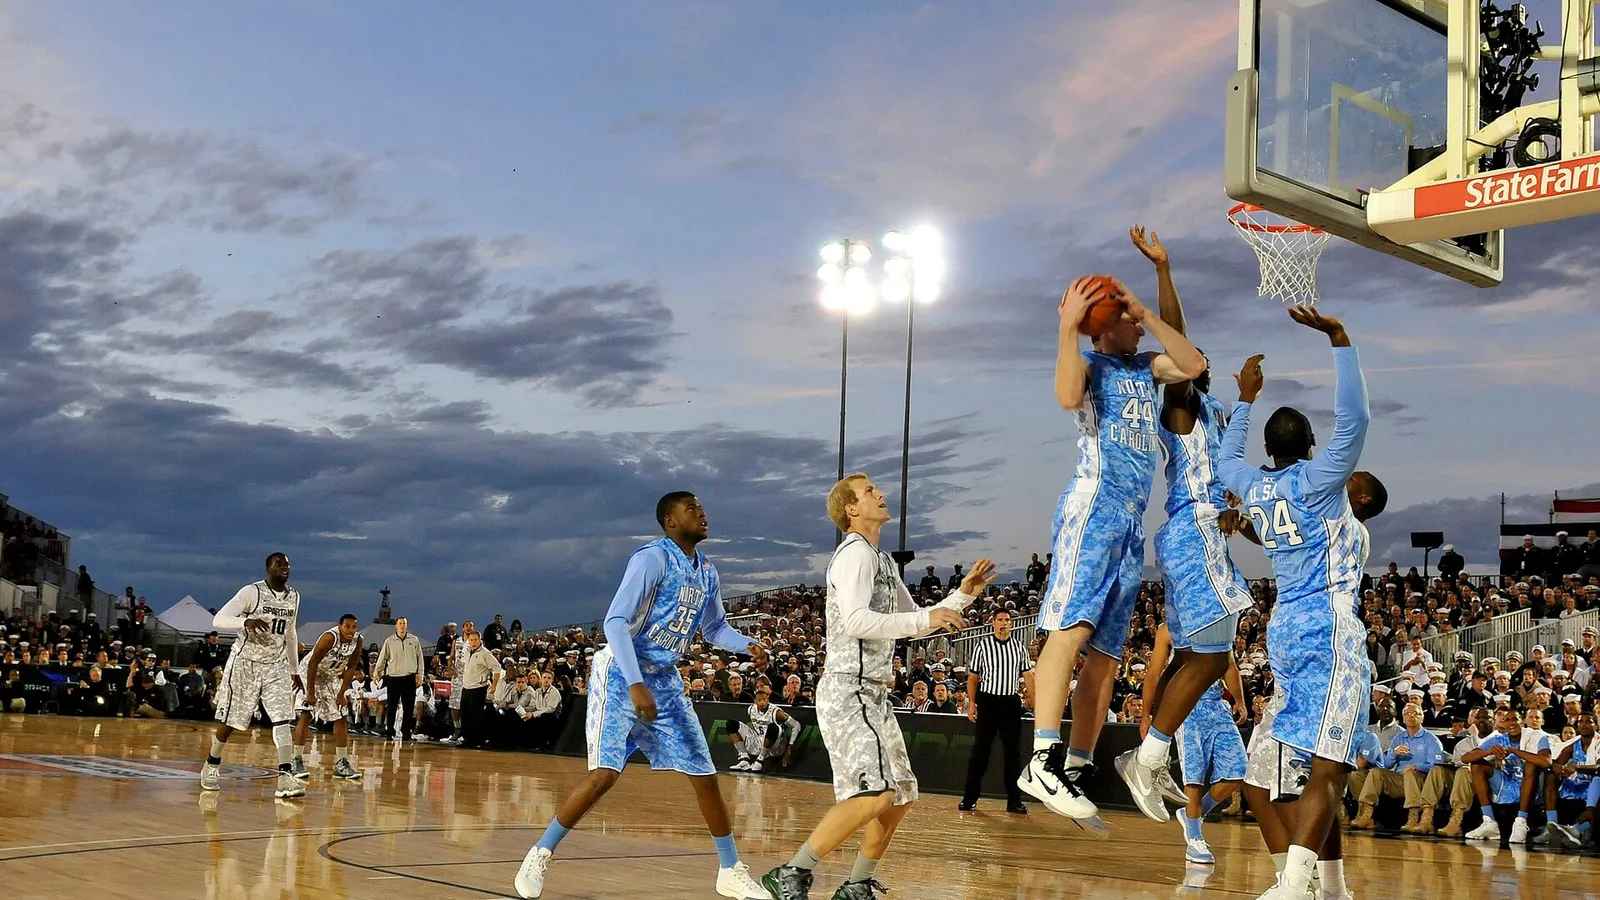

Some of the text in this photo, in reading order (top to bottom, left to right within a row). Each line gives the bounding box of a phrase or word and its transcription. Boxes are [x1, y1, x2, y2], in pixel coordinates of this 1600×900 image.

[1464, 170, 1538, 208] State
[1121, 397, 1155, 434] 44
[1110, 423, 1157, 452] CAROLIN
[1249, 498, 1305, 549] 24
[271, 618, 287, 635] 10
[668, 605, 698, 635] 35
